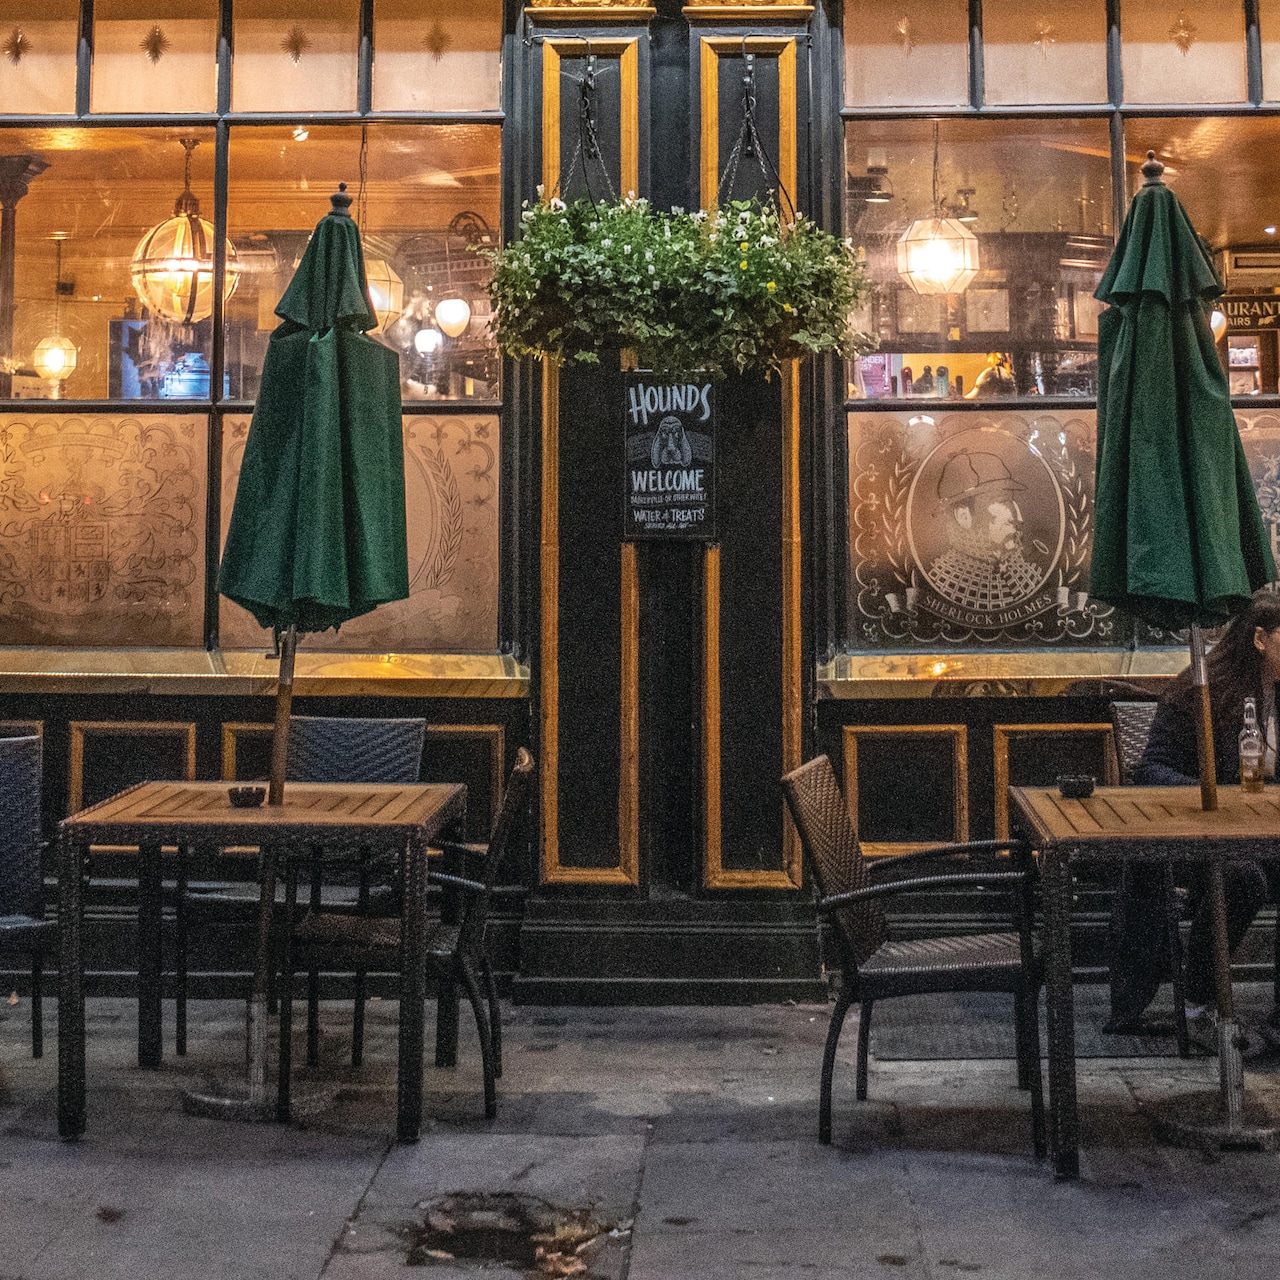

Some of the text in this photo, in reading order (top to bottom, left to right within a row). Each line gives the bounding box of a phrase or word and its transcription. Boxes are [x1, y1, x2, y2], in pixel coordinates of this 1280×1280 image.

[1228, 316, 1251, 326] AIRS
[629, 383, 712, 425] HOUNDS
[631, 469, 704, 492] WELCOME
[633, 509, 661, 522] WATER
[670, 507, 705, 522] TREATS
[924, 594, 1052, 625] SHERLOCK HOLMES
